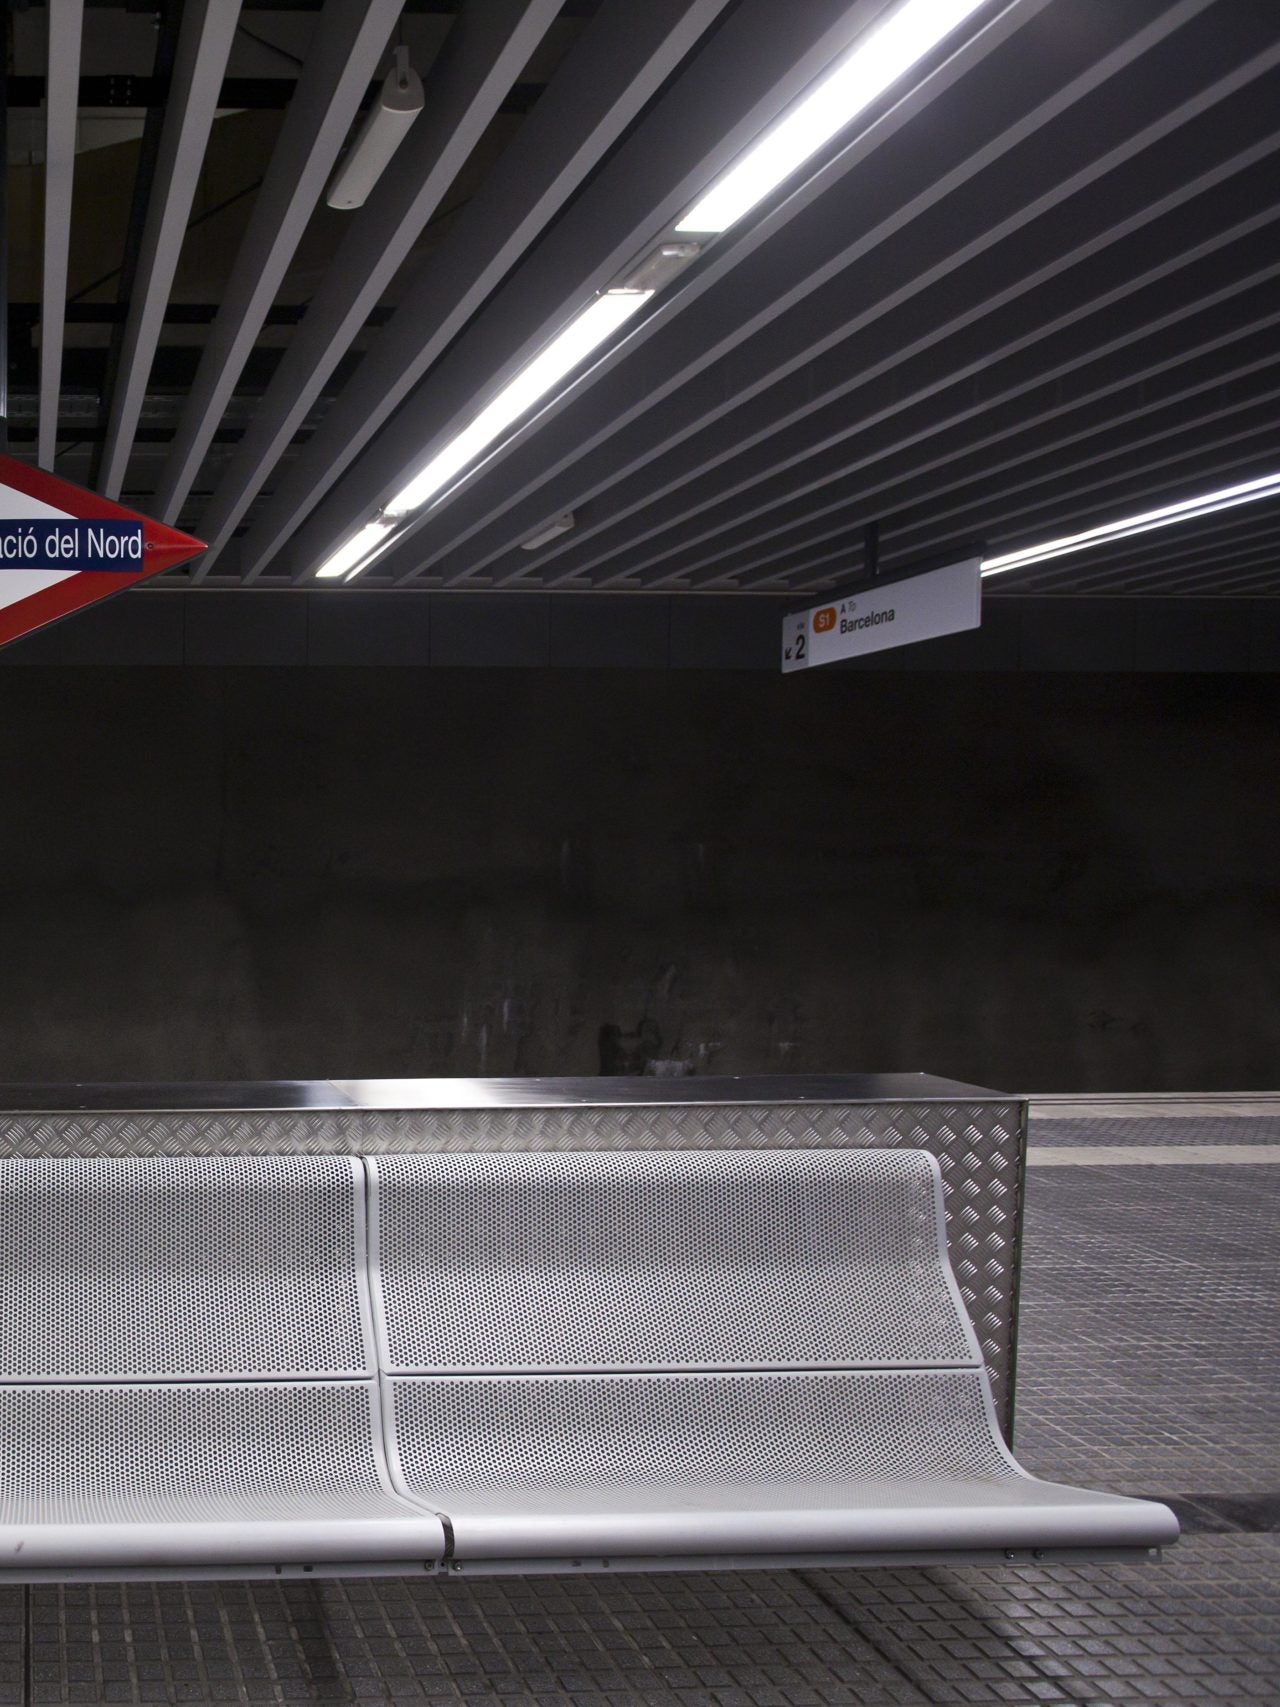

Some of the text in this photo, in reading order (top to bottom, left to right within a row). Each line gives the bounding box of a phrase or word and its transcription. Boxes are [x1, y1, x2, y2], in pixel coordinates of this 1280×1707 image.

[45, 529, 80, 558] del
[87, 528, 142, 559] Nord
[819, 614, 831, 628] S1
[840, 609, 896, 634] Barcelona
[795, 634, 805, 660] 2
